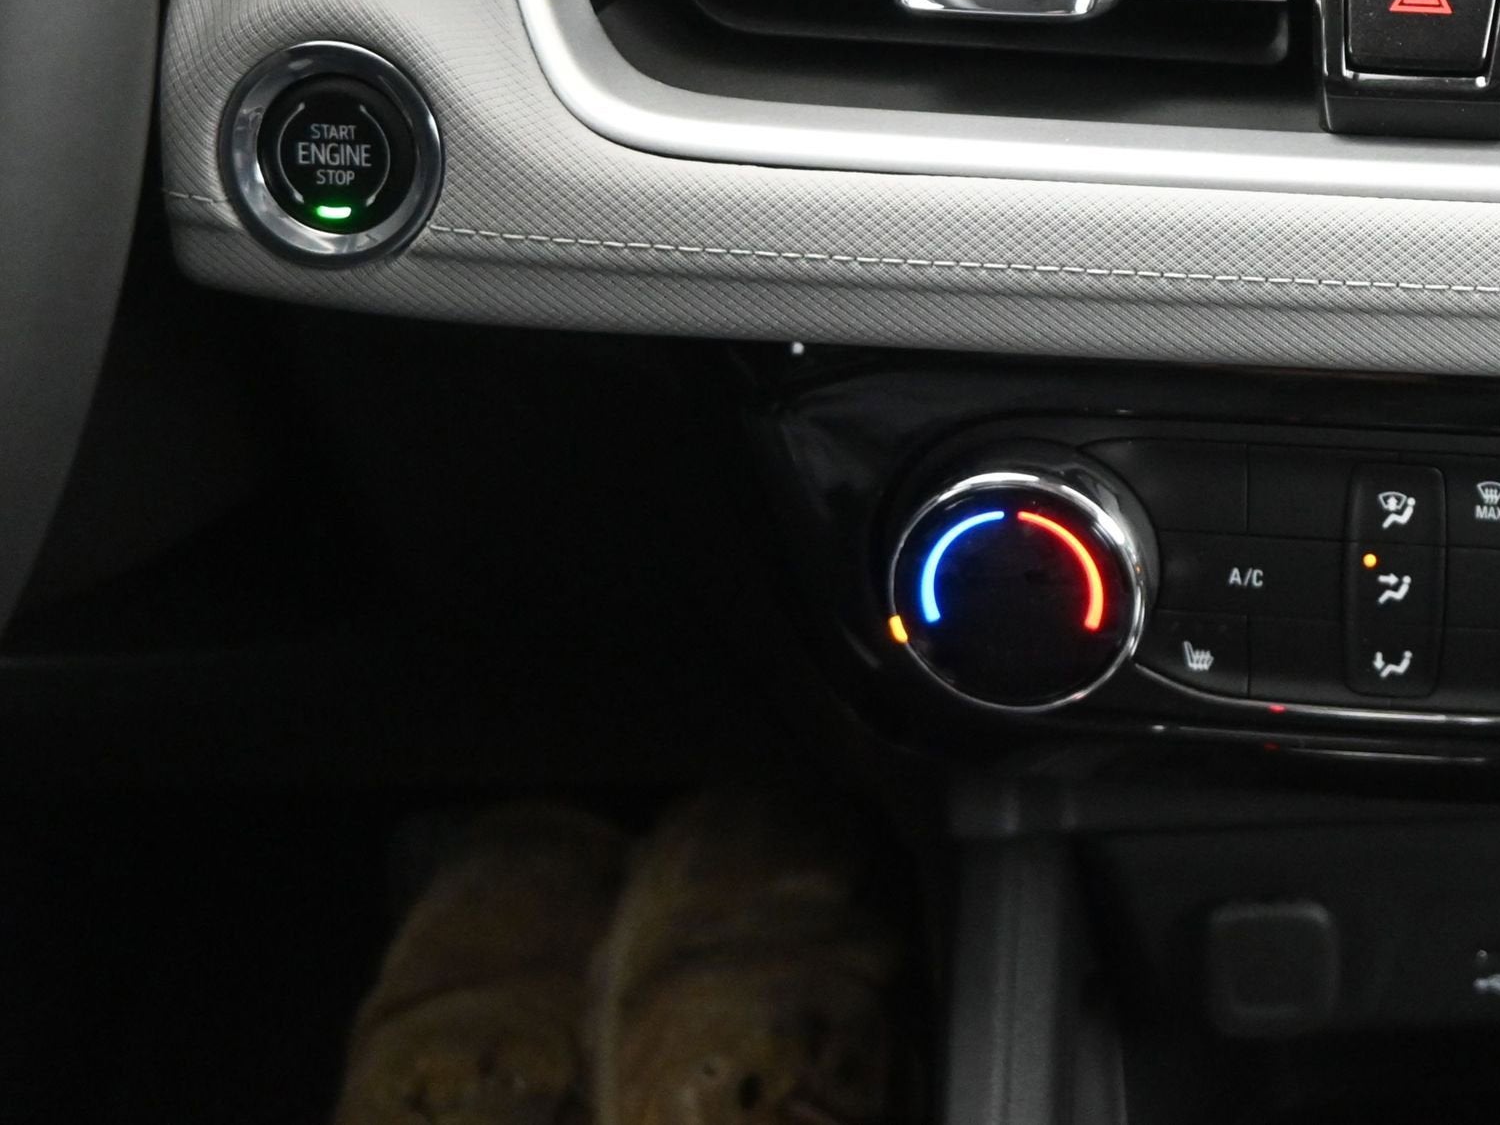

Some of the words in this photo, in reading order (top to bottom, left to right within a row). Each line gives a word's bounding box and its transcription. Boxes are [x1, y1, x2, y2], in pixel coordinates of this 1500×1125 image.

[310, 123, 357, 140] START
[297, 141, 372, 168] ENGINE
[316, 169, 356, 186] STOP
[1228, 568, 1264, 588] A/C
